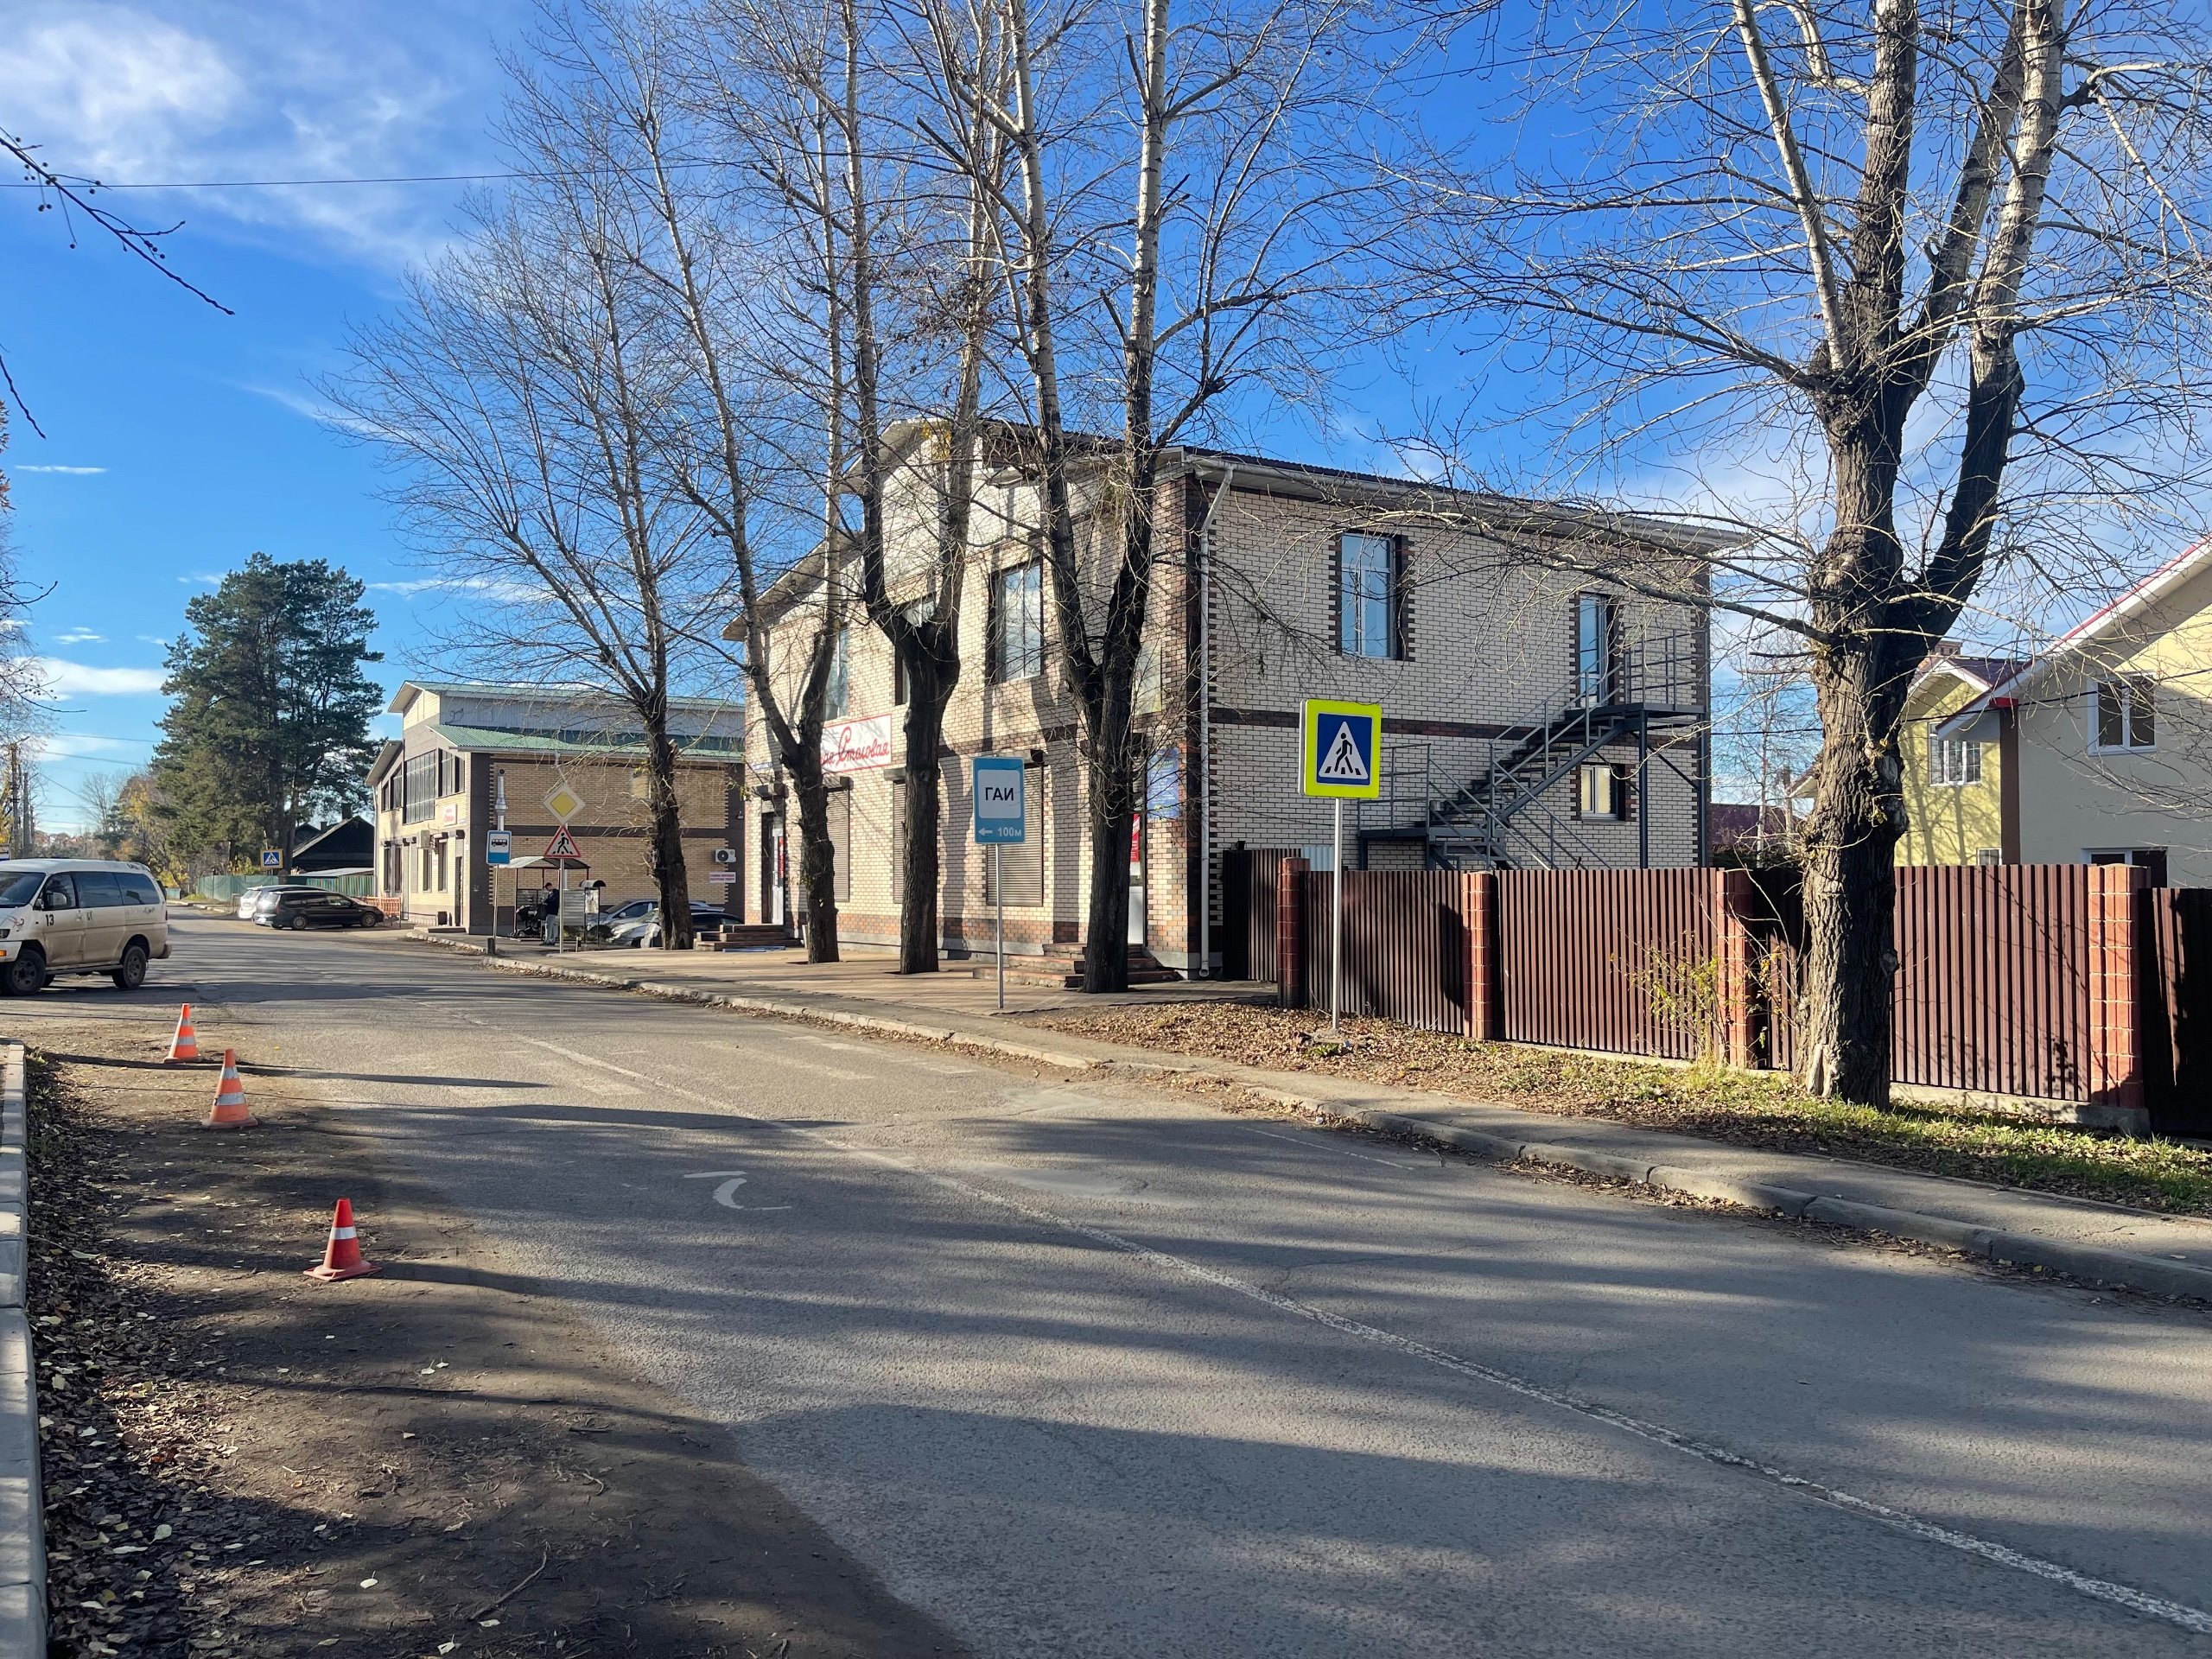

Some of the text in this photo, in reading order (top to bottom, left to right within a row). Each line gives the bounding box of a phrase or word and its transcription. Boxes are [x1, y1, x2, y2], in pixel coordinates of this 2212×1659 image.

[985, 787, 1014, 801] ГАИ
[998, 827, 1022, 837] 100м
[45, 913, 54, 927] 13
